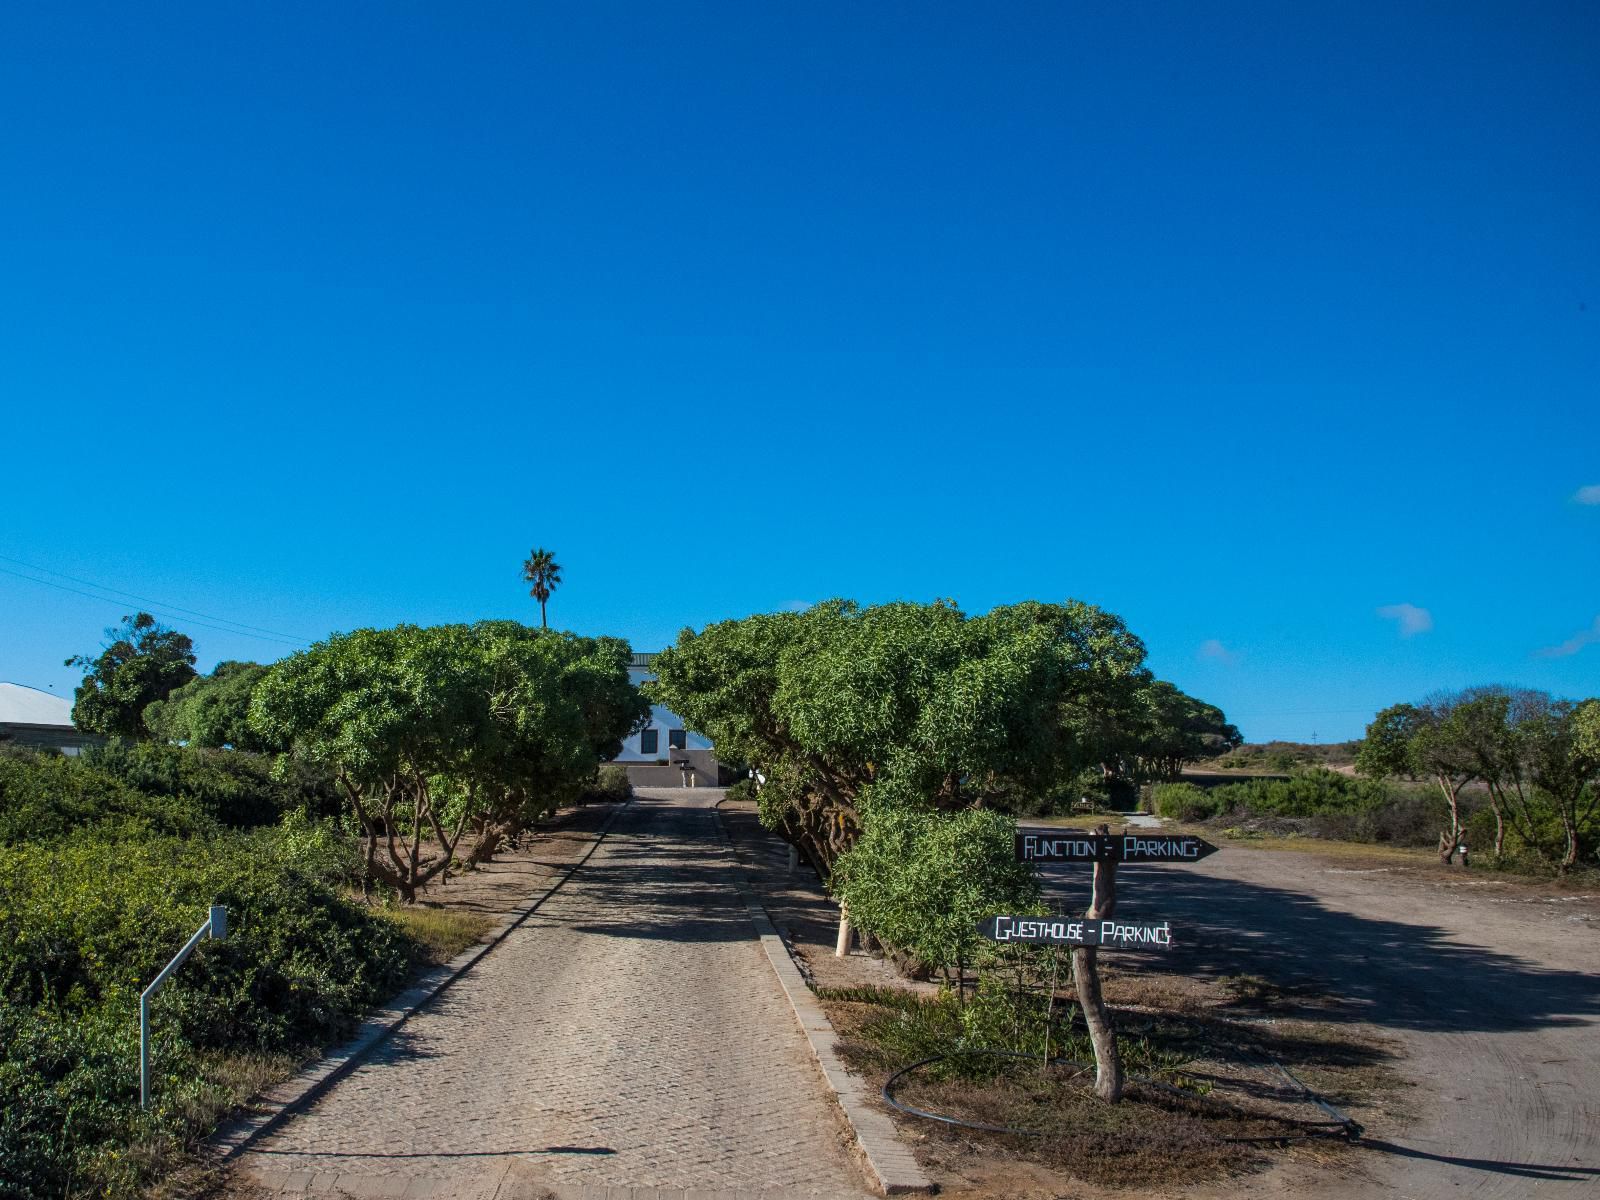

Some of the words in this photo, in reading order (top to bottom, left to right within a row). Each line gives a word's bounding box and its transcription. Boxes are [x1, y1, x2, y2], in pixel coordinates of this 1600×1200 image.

[1024, 836, 1096, 859] FUNCTION
[1123, 836, 1199, 859] PARKING
[995, 916, 1083, 940] GUESTHOUSE
[1101, 921, 1171, 944] PARKING
